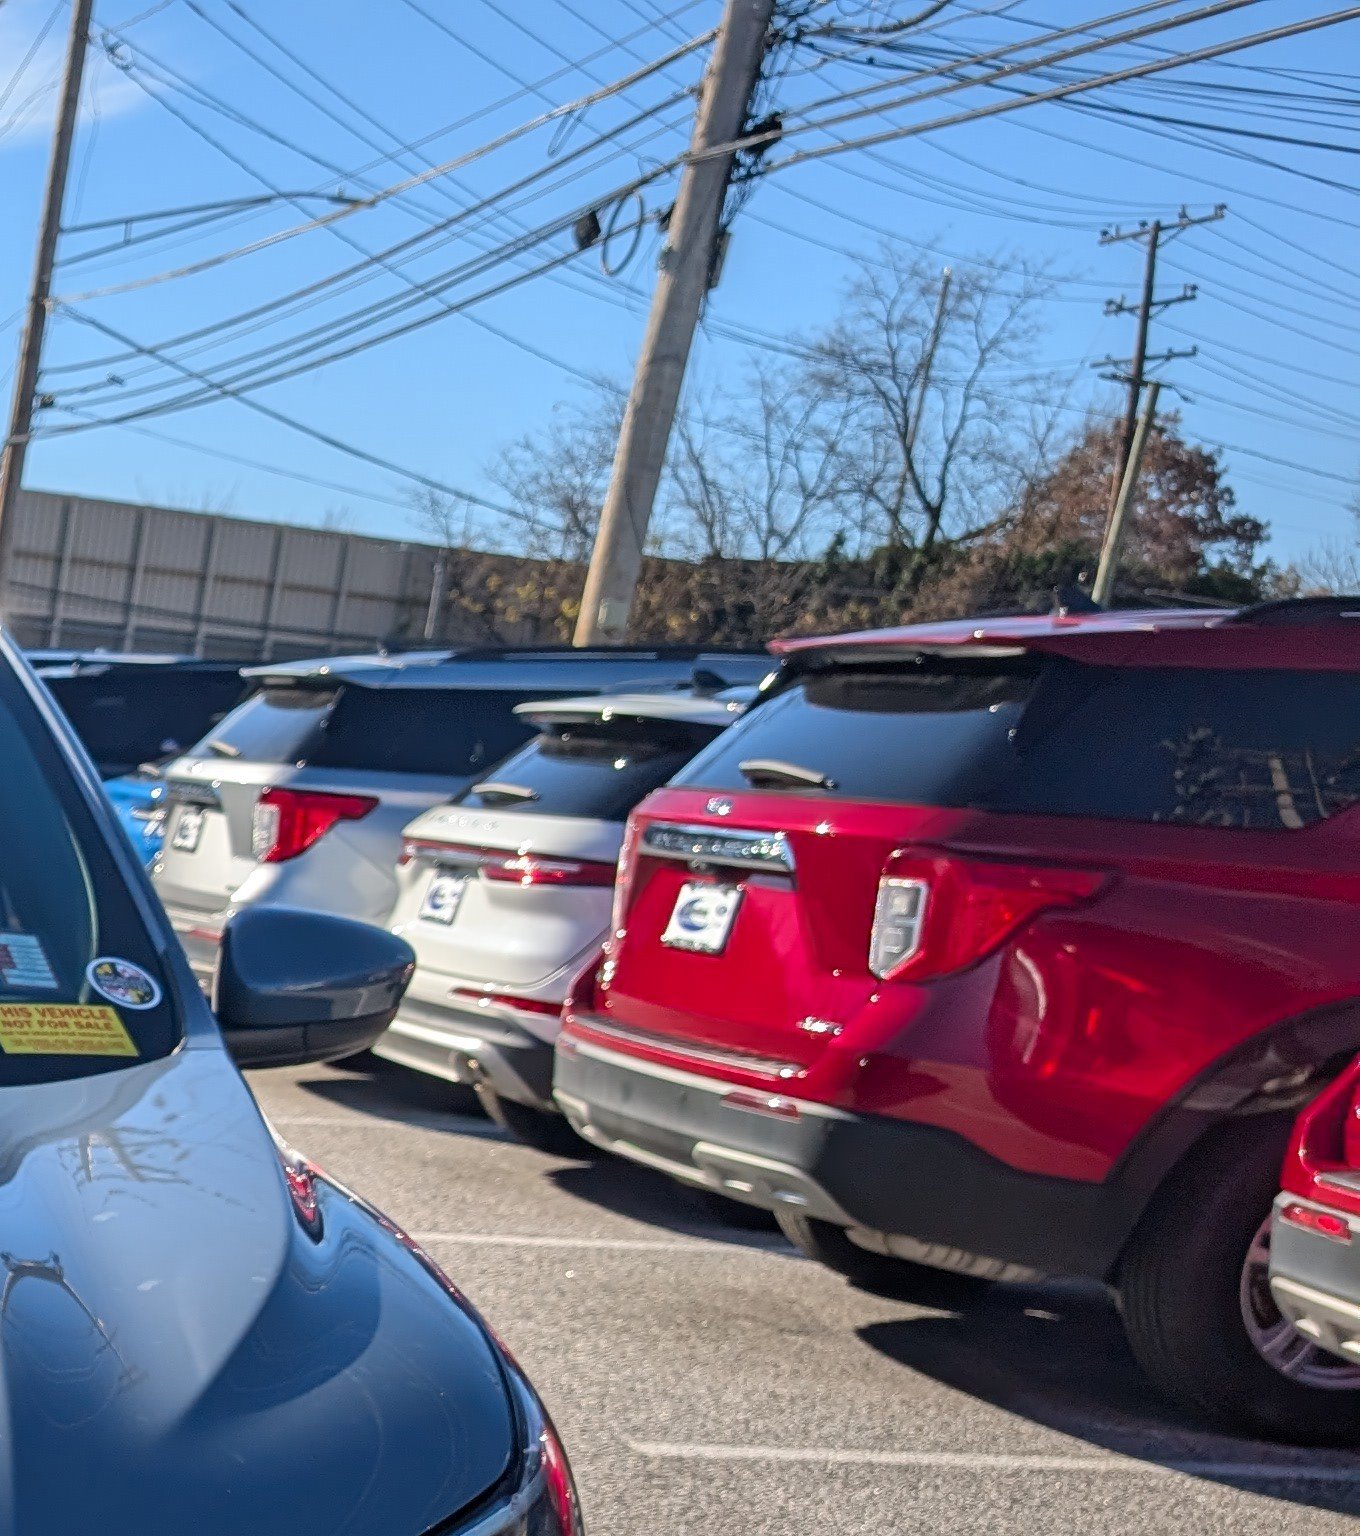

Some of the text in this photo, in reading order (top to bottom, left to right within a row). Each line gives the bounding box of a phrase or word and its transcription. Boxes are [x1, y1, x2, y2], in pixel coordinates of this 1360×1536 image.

[35, 1007, 111, 1020] VEHICLE
[1, 1019, 114, 1031] NOT FOR SALE
